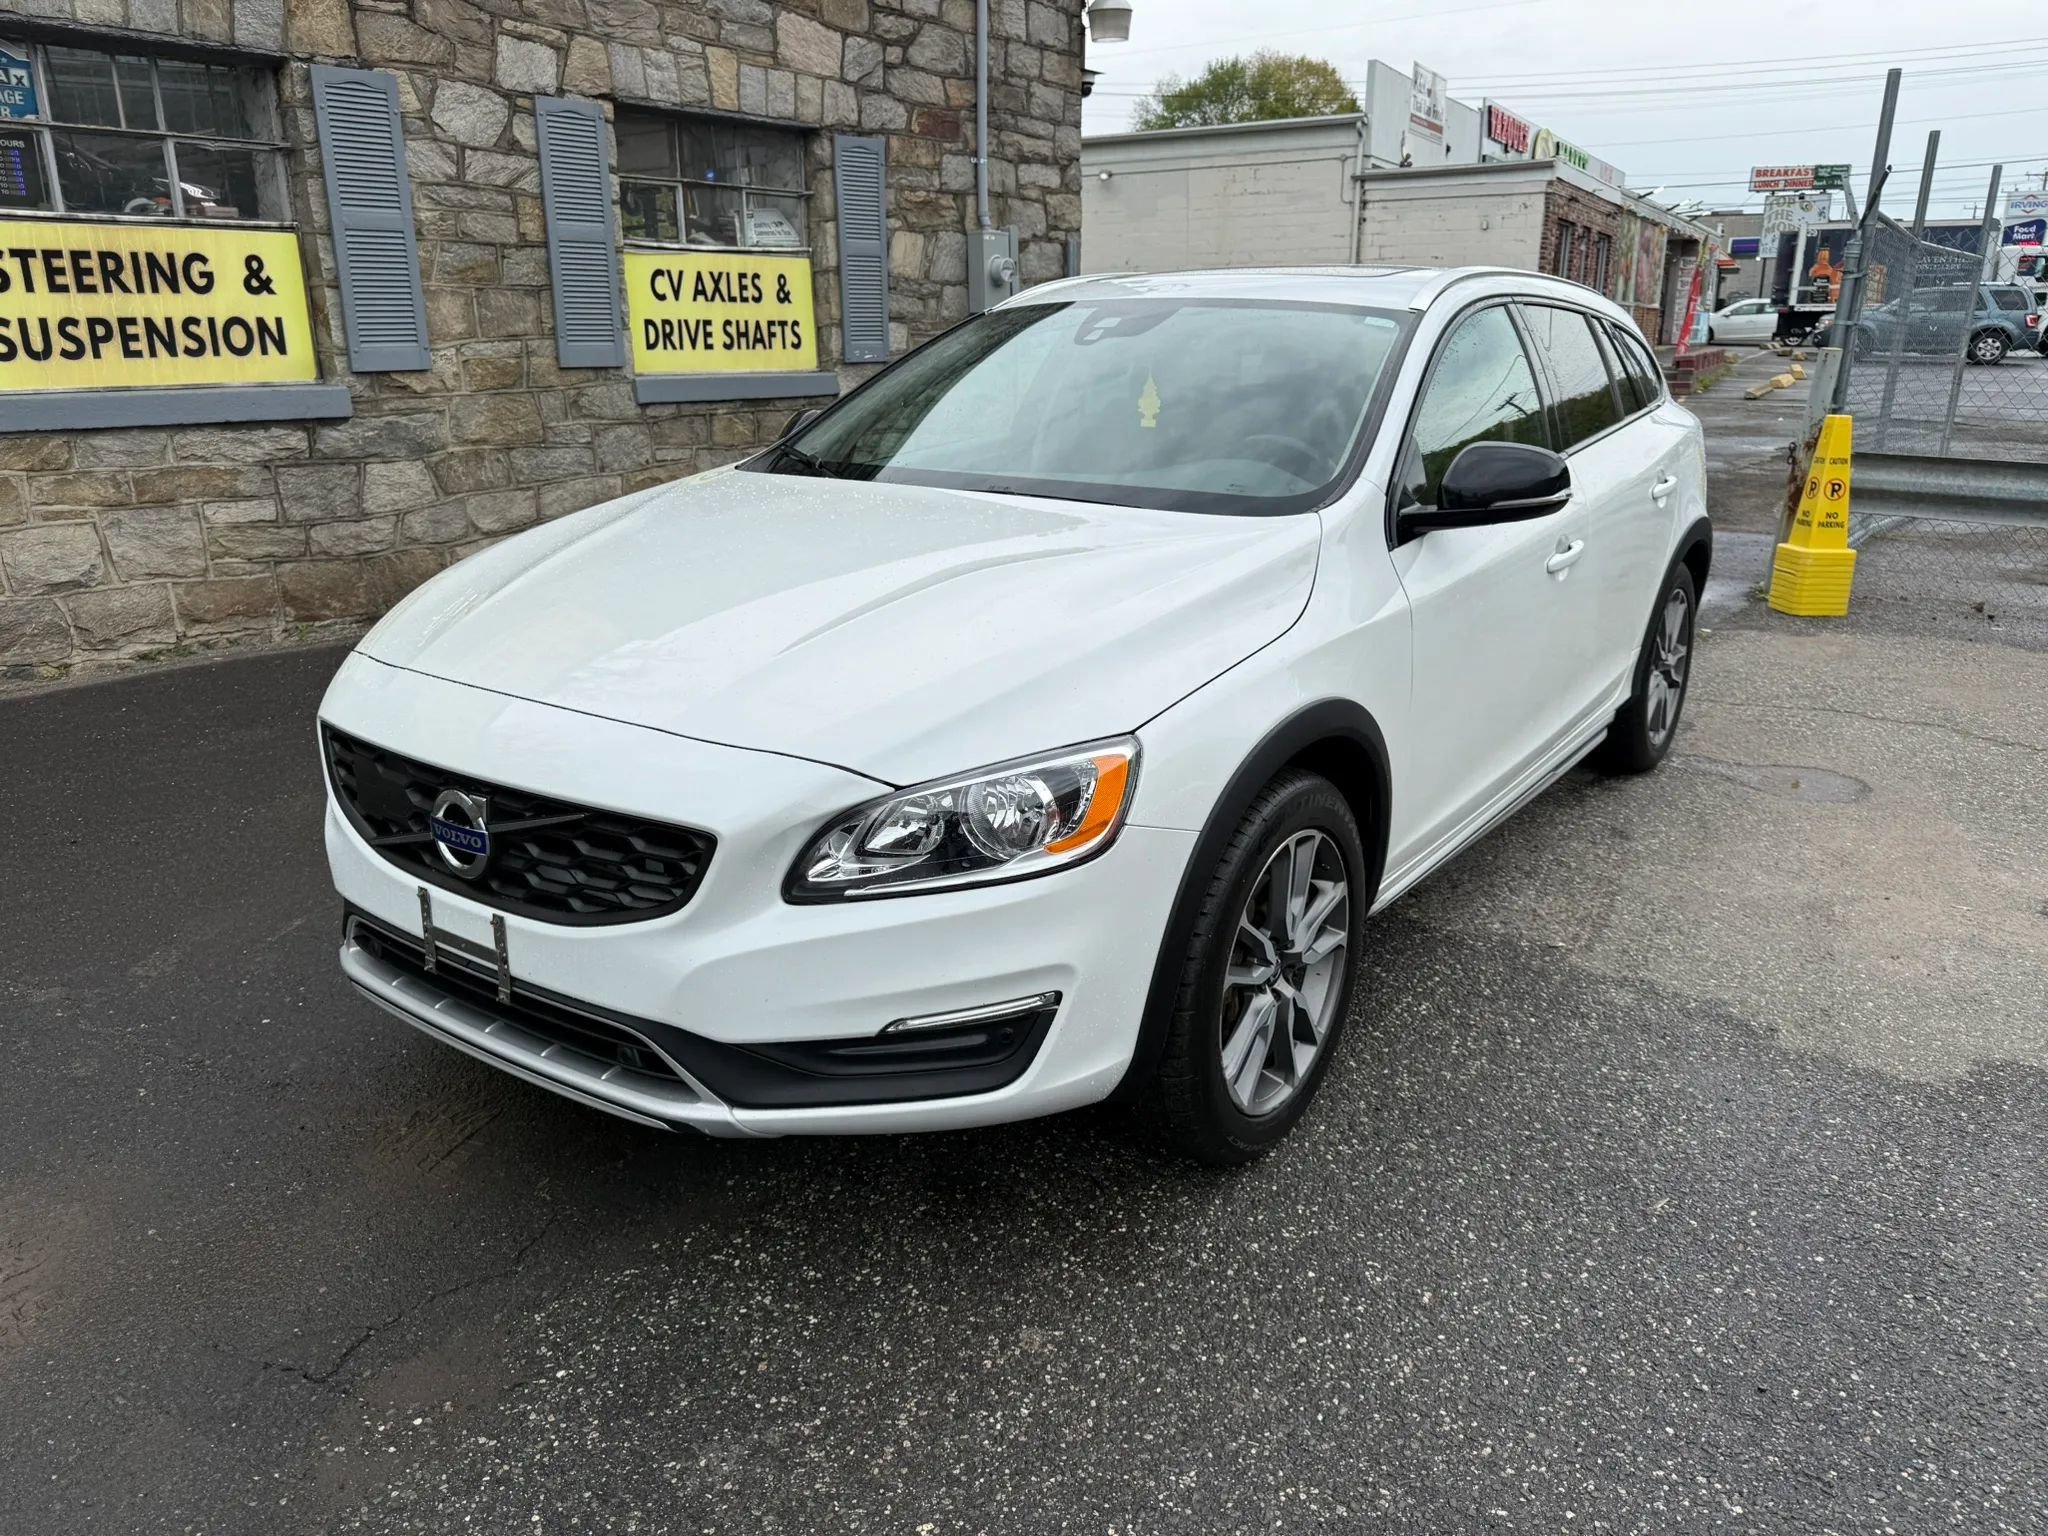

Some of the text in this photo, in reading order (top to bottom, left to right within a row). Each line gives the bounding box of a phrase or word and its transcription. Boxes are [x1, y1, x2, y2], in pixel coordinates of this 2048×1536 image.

[1755, 167, 1815, 178] BREAKFAST
[1753, 181, 1779, 189] LUNCH
[1784, 178, 1814, 188] DINNER
[2010, 200, 2048, 209] IRVING
[2014, 224, 2037, 233] Food
[2012, 232, 2036, 241] Mart
[242, 254, 277, 296] &
[650, 268, 793, 304] CV AXLES &
[0, 315, 288, 362] SUSPENSION
[643, 318, 802, 351] DRIVE SHAFTS
[1829, 457, 1849, 465] CAUTION
[1825, 511, 1839, 520] NO
[1817, 520, 1846, 529] PARKING
[432, 822, 482, 848] VOLVO
